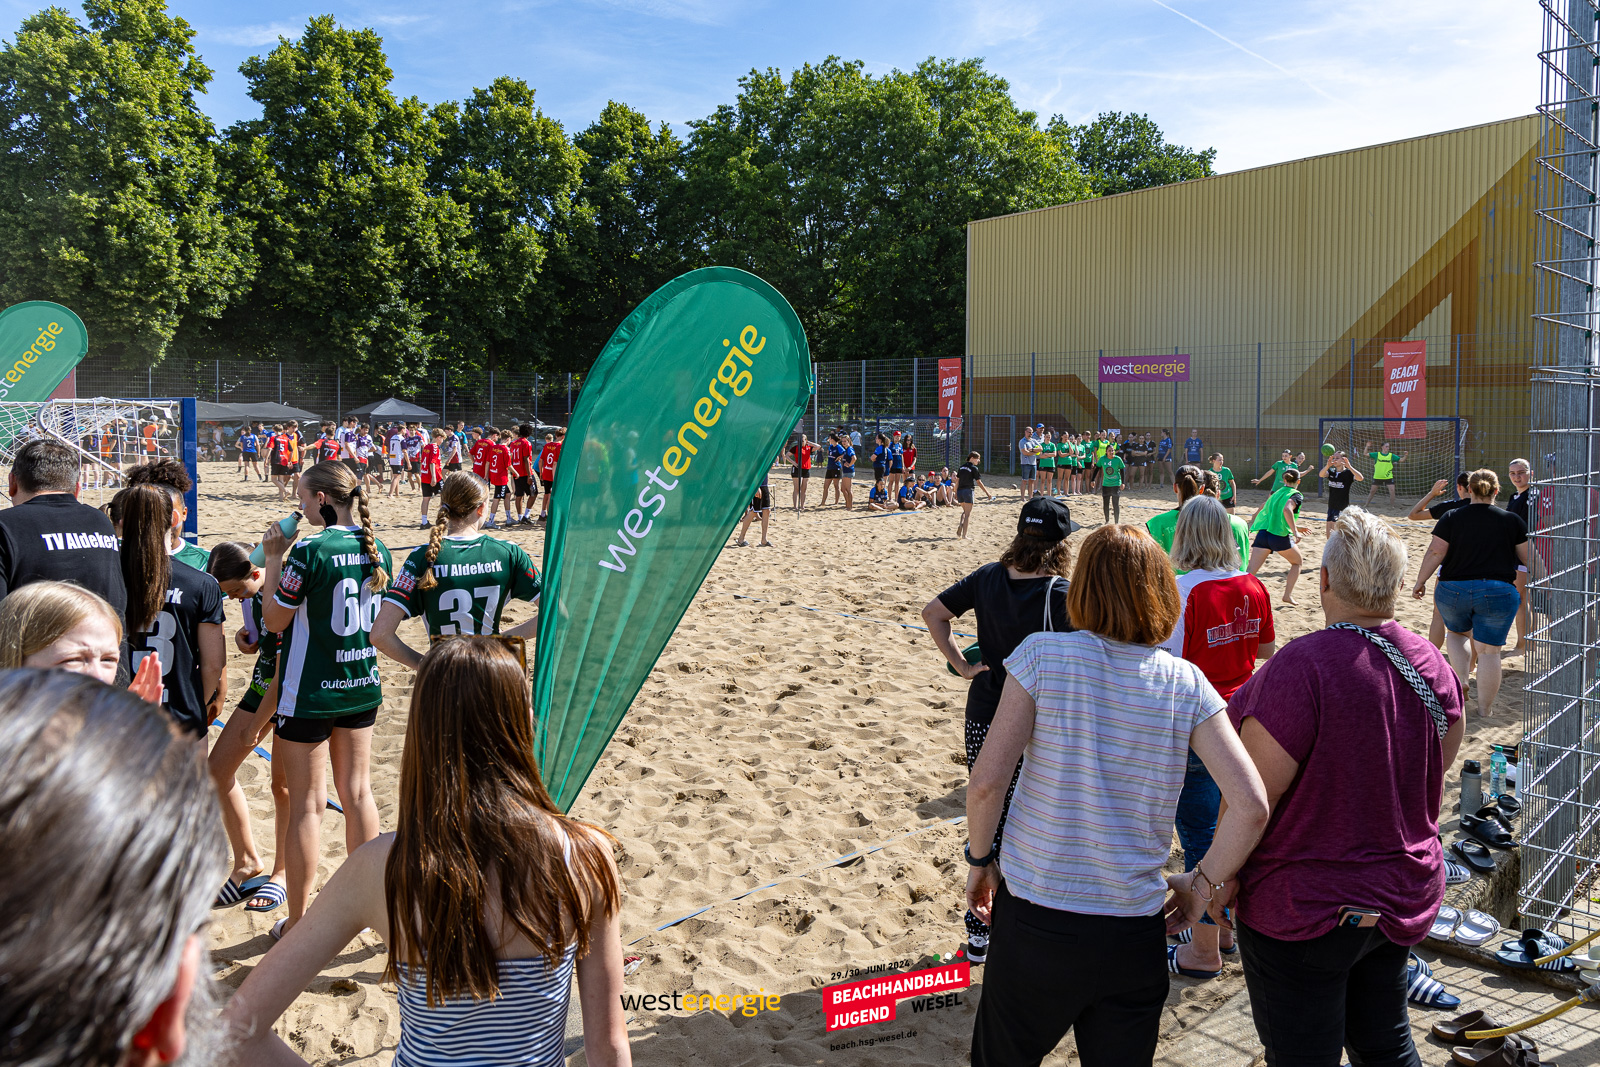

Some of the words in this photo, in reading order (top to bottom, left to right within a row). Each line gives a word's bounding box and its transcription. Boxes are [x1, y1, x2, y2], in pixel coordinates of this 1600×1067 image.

[0, 321, 64, 400] stenergie
[1102, 360, 1186, 377] westenergie
[1390, 364, 1419, 380] BEACH
[942, 376, 958, 387] BEACH
[1390, 379, 1419, 395] COURT
[942, 386, 958, 398] COURT
[1400, 397, 1409, 435] 1
[323, 447, 336, 458] 77
[476, 447, 484, 460] 5
[512, 447, 520, 460] 11
[597, 324, 767, 573] westenergie
[422, 459, 427, 469] 4
[491, 454, 498, 467] 3
[546, 452, 554, 465] 6
[40, 532, 65, 551] TV
[331, 554, 346, 568] TV
[347, 551, 384, 566] Aldekk
[433, 564, 448, 578] TV
[451, 559, 502, 577] Aldekerk
[331, 576, 381, 637] 66
[438, 585, 501, 635] 37
